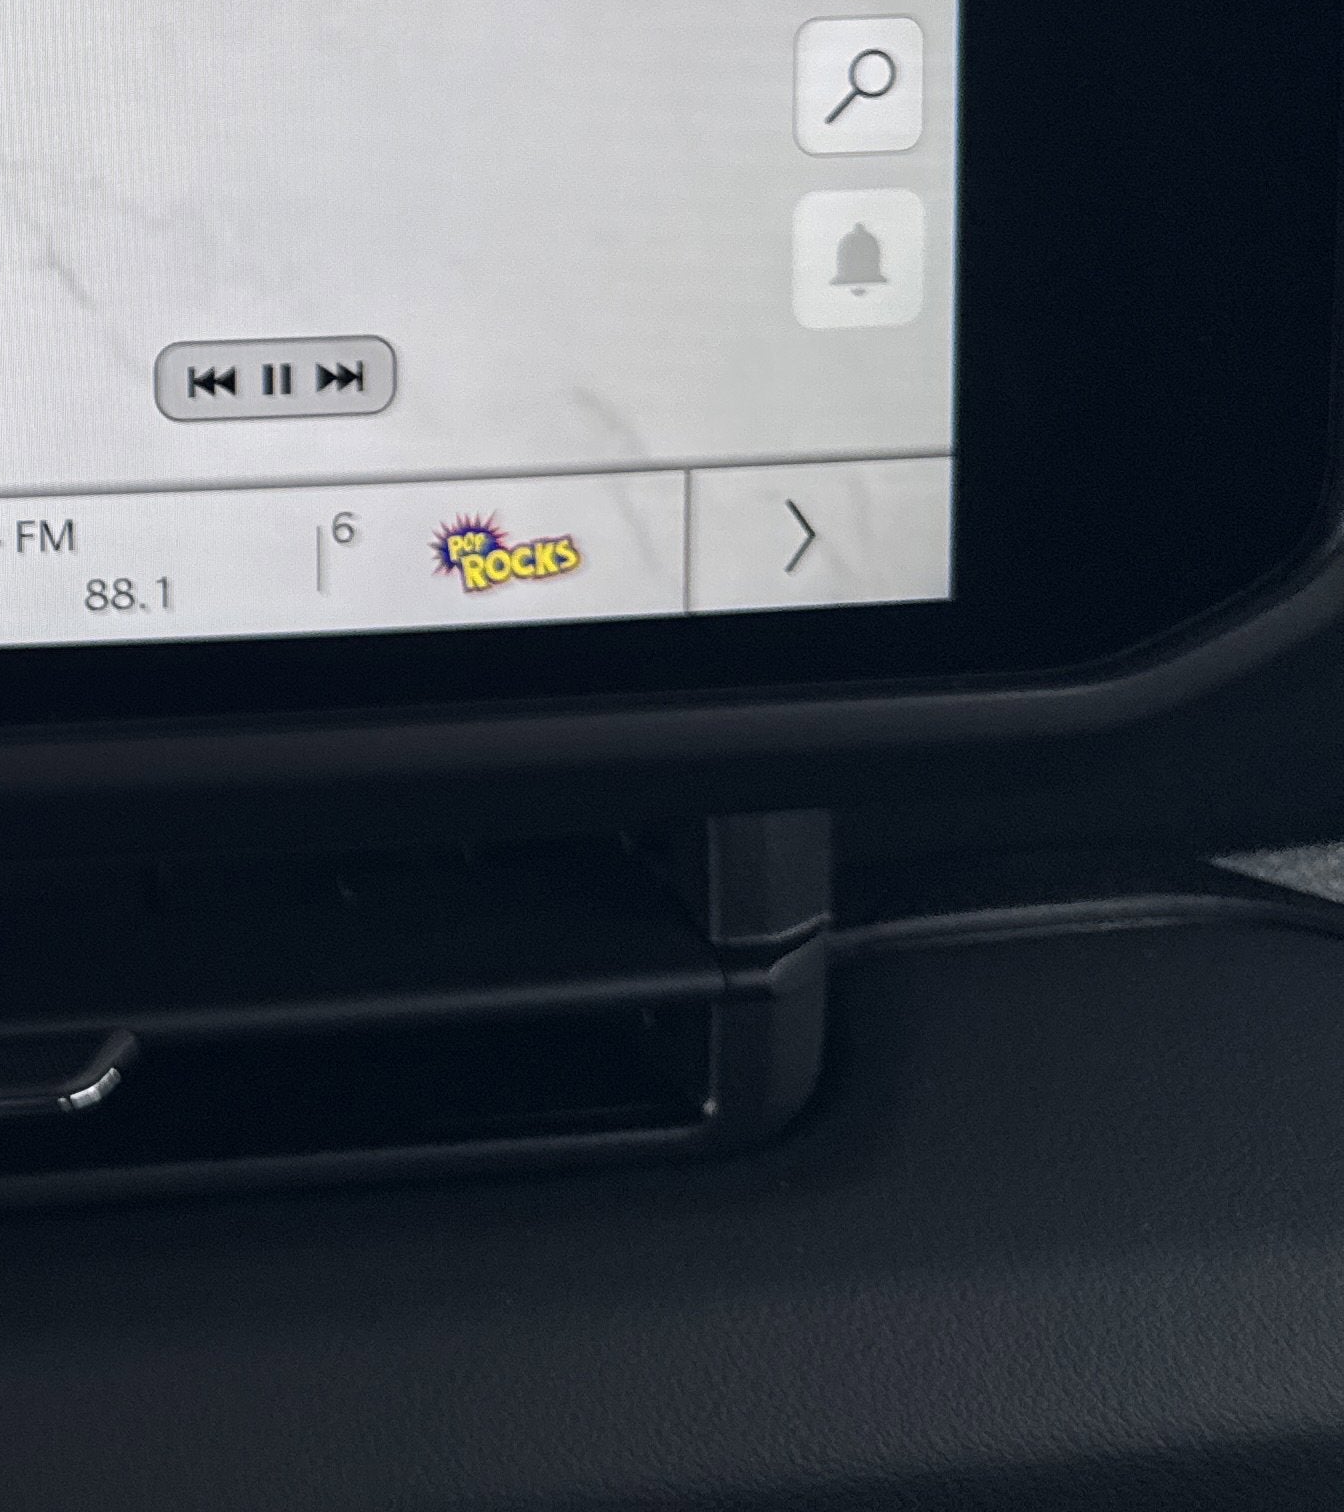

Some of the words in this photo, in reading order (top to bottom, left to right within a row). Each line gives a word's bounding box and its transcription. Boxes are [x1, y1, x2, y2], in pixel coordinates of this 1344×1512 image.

[15, 519, 76, 554] FM
[331, 512, 355, 544] 6
[462, 539, 580, 590] ROCKS
[84, 576, 173, 613] 88.1
